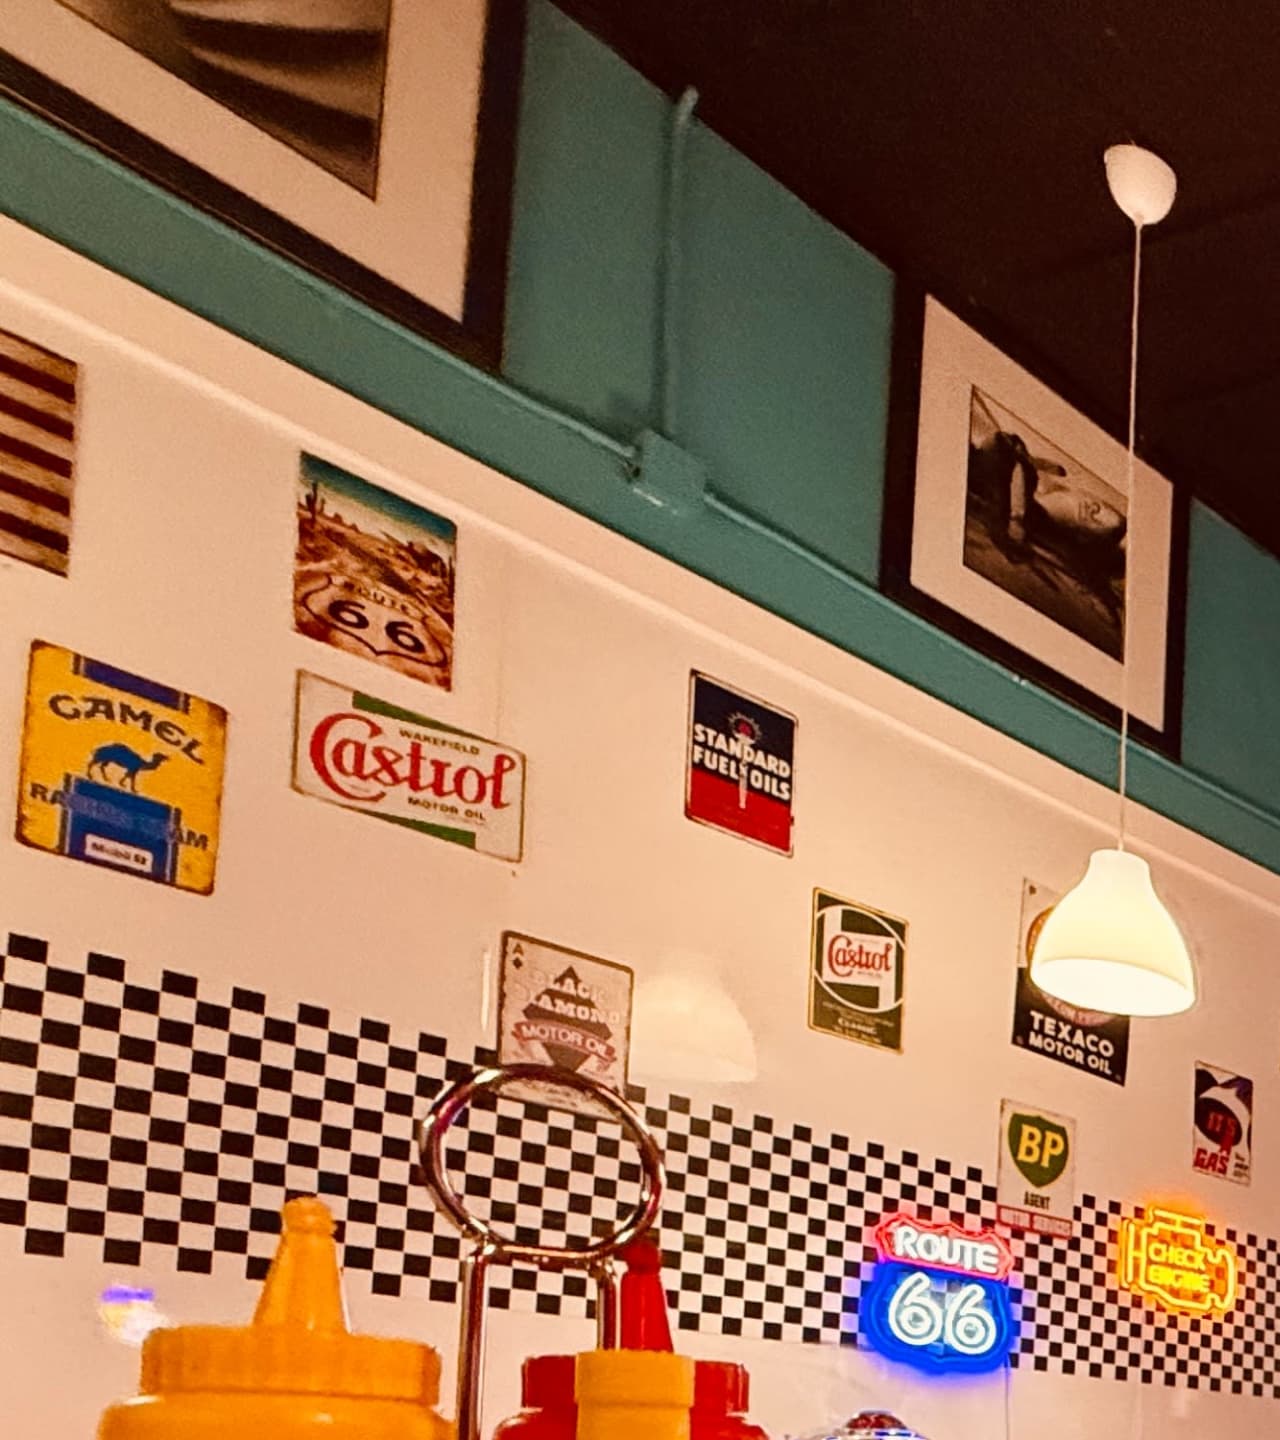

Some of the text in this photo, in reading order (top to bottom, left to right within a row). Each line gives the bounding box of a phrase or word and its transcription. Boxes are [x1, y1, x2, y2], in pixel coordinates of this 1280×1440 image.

[328, 600, 425, 654] 66
[48, 694, 206, 766] CAMEL
[399, 729, 481, 756] WAKEFIELD
[693, 723, 791, 779] STANDARD
[309, 712, 517, 809] Castrol
[692, 745, 791, 801] FUEL OILS
[407, 797, 460, 816] MOTOR
[464, 808, 487, 822] OIL
[512, 943, 524, 956] A
[827, 933, 893, 978] Castrol
[521, 1024, 583, 1047] MOTOR
[1028, 1031, 1113, 1076] MOTOR OIL
[1029, 1010, 1115, 1058] TEXACO
[1017, 1123, 1064, 1168] BP
[1193, 1147, 1229, 1175] GAS
[893, 1225, 1001, 1275] ROUTE
[1148, 1242, 1206, 1271] CHECK
[1148, 1264, 1210, 1293] ENGINE
[888, 1271, 998, 1355] 66
